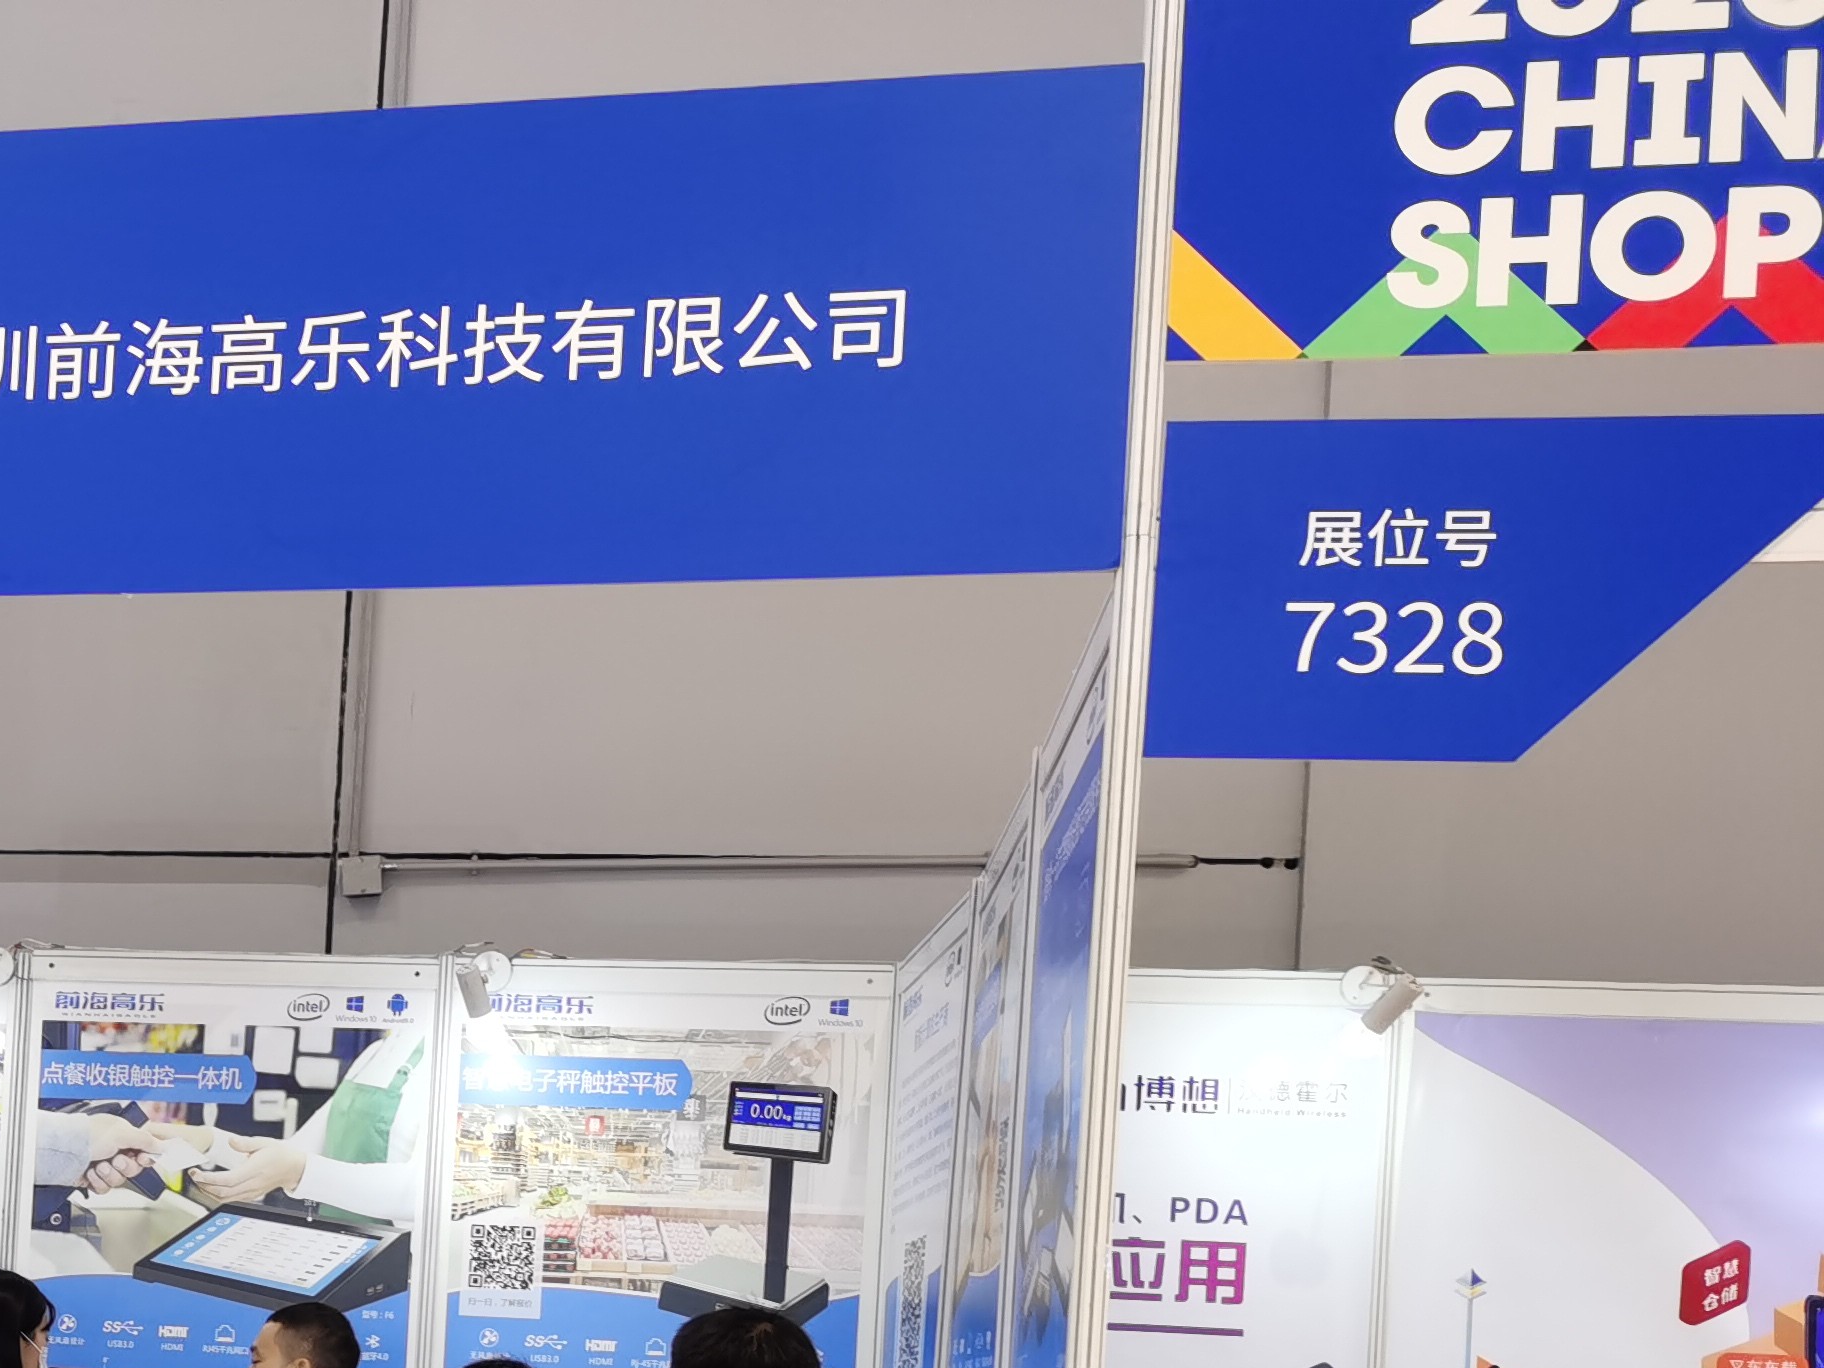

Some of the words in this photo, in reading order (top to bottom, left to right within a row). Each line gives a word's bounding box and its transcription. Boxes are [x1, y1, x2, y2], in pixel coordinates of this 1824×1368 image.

[1394, 50, 1824, 176] CHIN
[1387, 186, 1823, 310] SHOP
[1299, 508, 1498, 568] 展位号
[1285, 601, 1505, 675] 7328
[55, 991, 164, 1012] 前海高乐
[290, 997, 327, 1016] intel
[767, 1000, 806, 1021] intel
[42, 1061, 242, 1091] 点餐收银触控一体机
[1121, 1075, 1219, 1114] 博想
[1110, 1236, 1247, 1305] 应用
[1703, 1258, 1739, 1287] 智慧
[1702, 1283, 1738, 1312] 仓储
[107, 1339, 135, 1349] USB3.0
[530, 1354, 560, 1363] USB3.0
